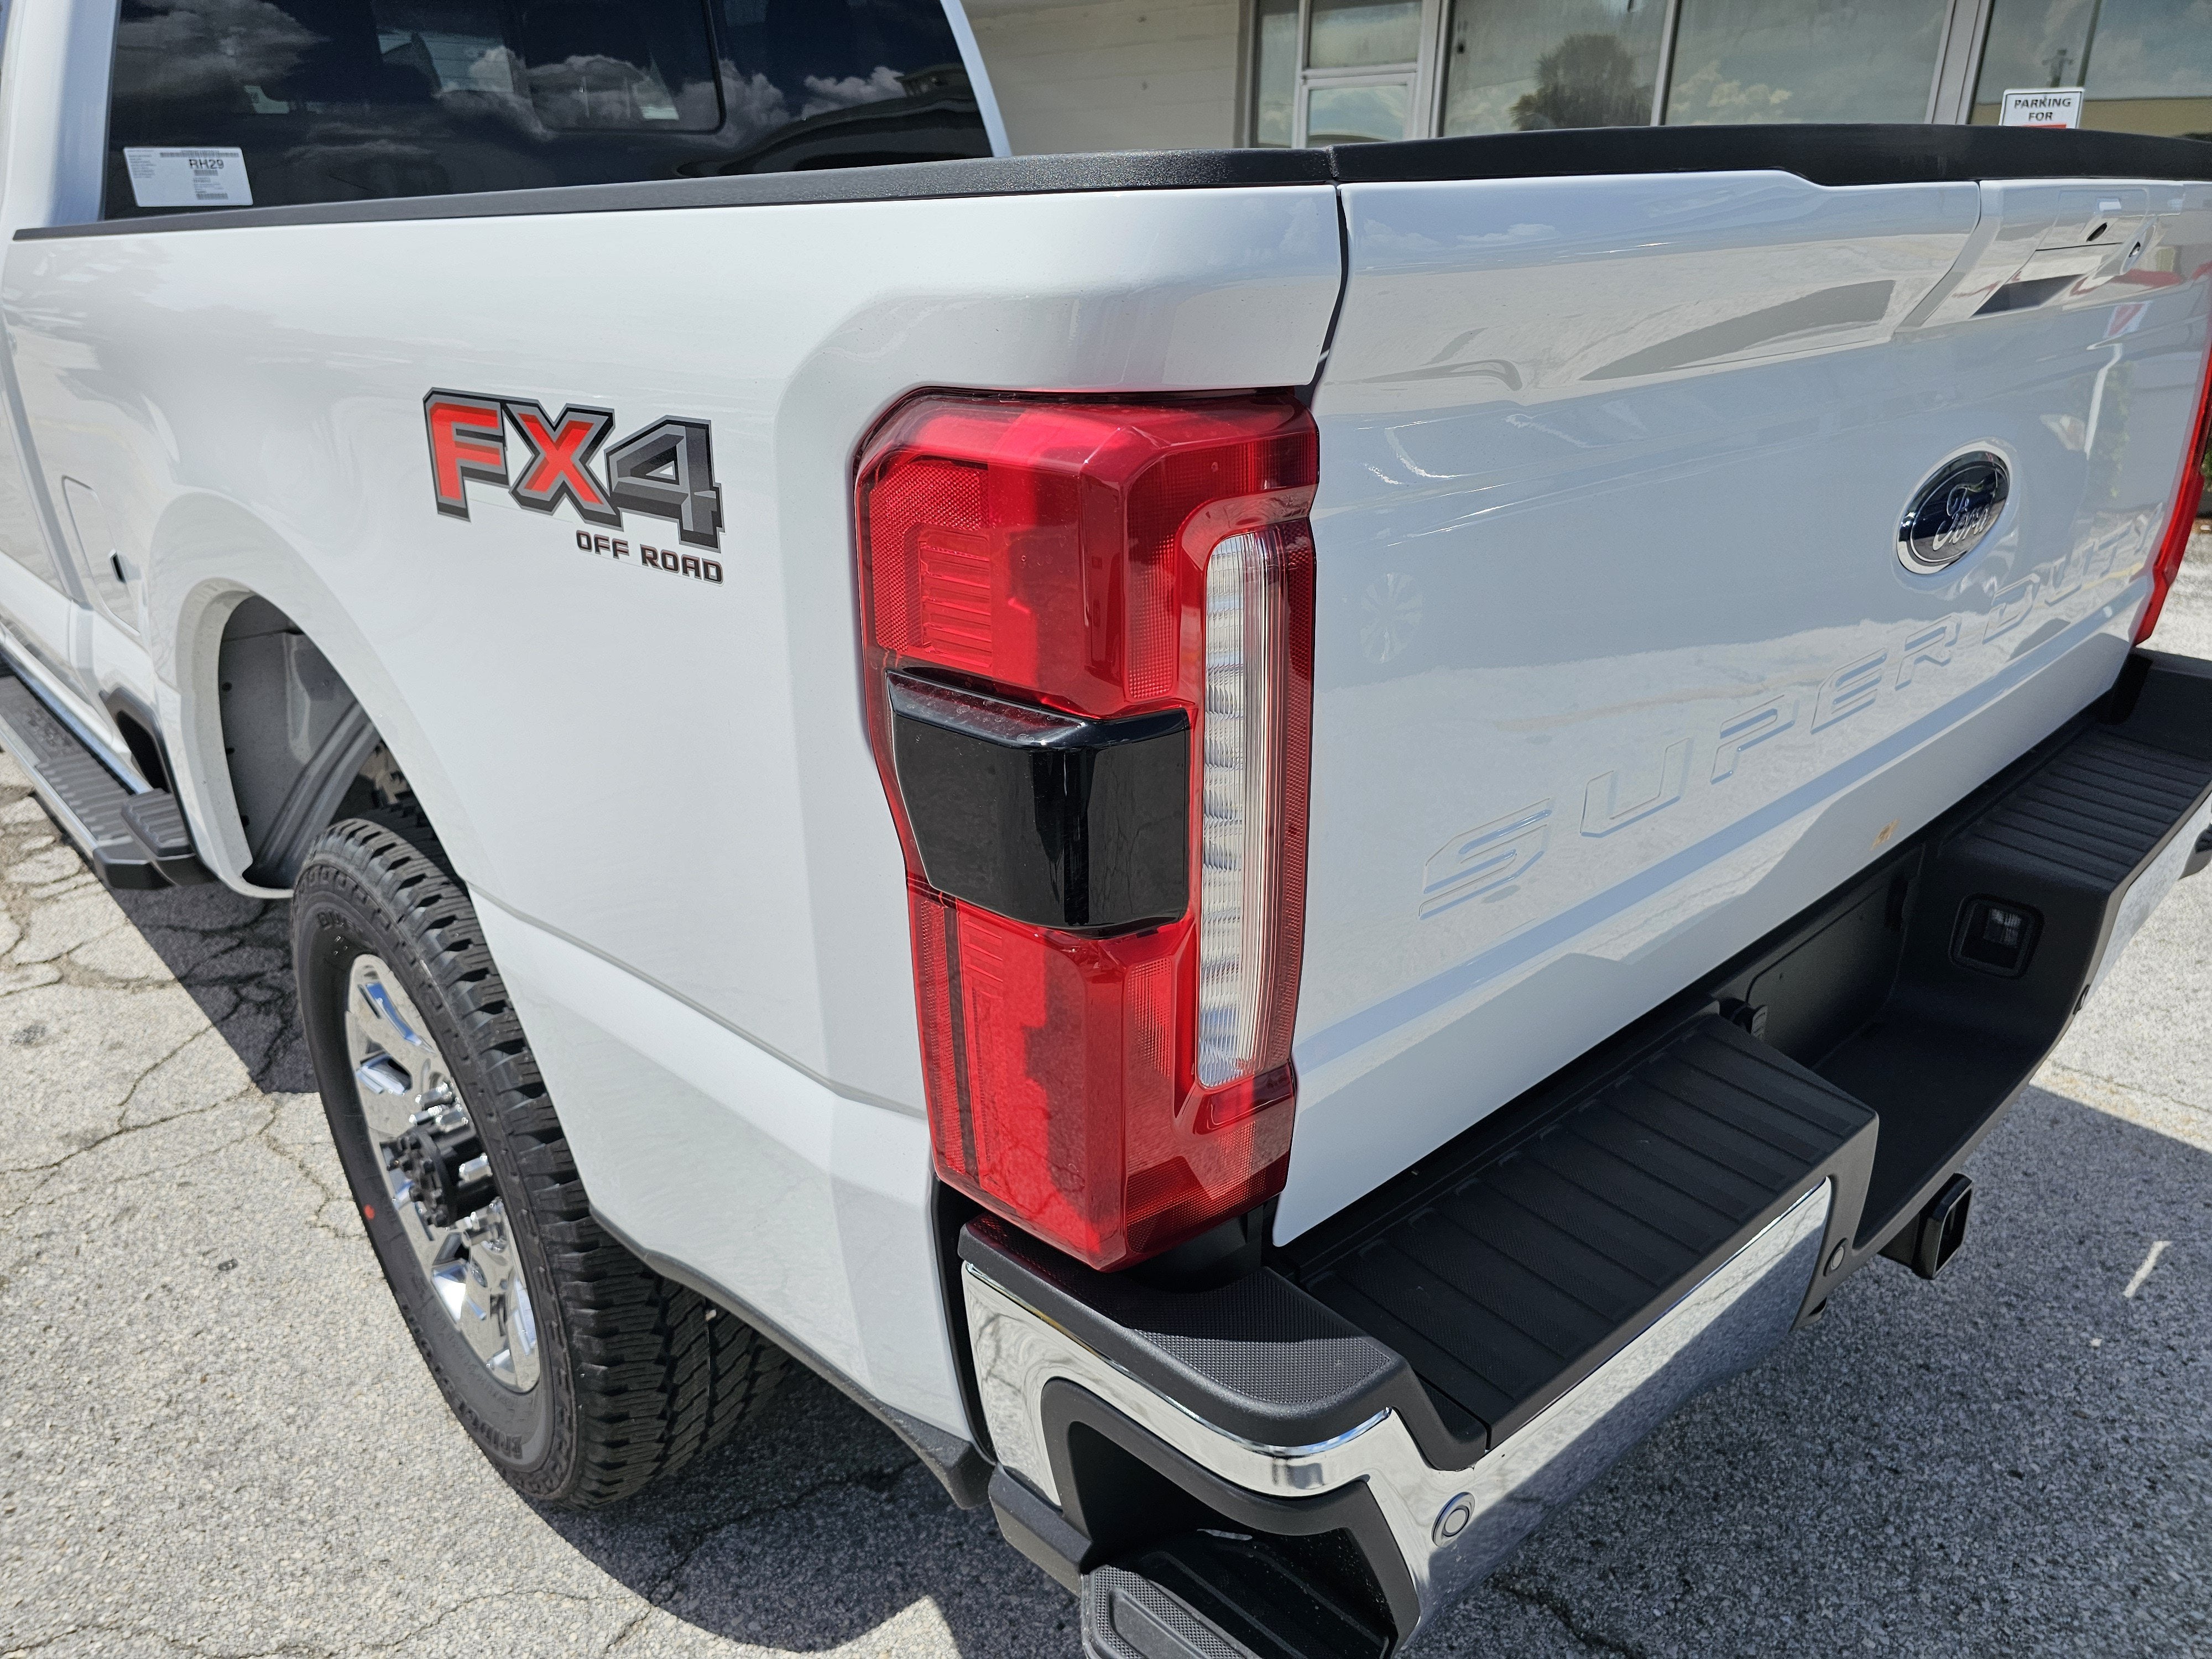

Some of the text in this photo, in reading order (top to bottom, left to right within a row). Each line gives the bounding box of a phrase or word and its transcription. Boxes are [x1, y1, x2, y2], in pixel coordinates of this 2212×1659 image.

[2013, 97, 2072, 109] PARKING
[2028, 112, 2053, 121] FOR
[189, 159, 225, 169] RH29
[422, 387, 726, 553] FX4
[1932, 478, 1991, 551] Ford
[576, 529, 724, 586] OFF ROAD
[1419, 611, 1962, 921] SUPER
